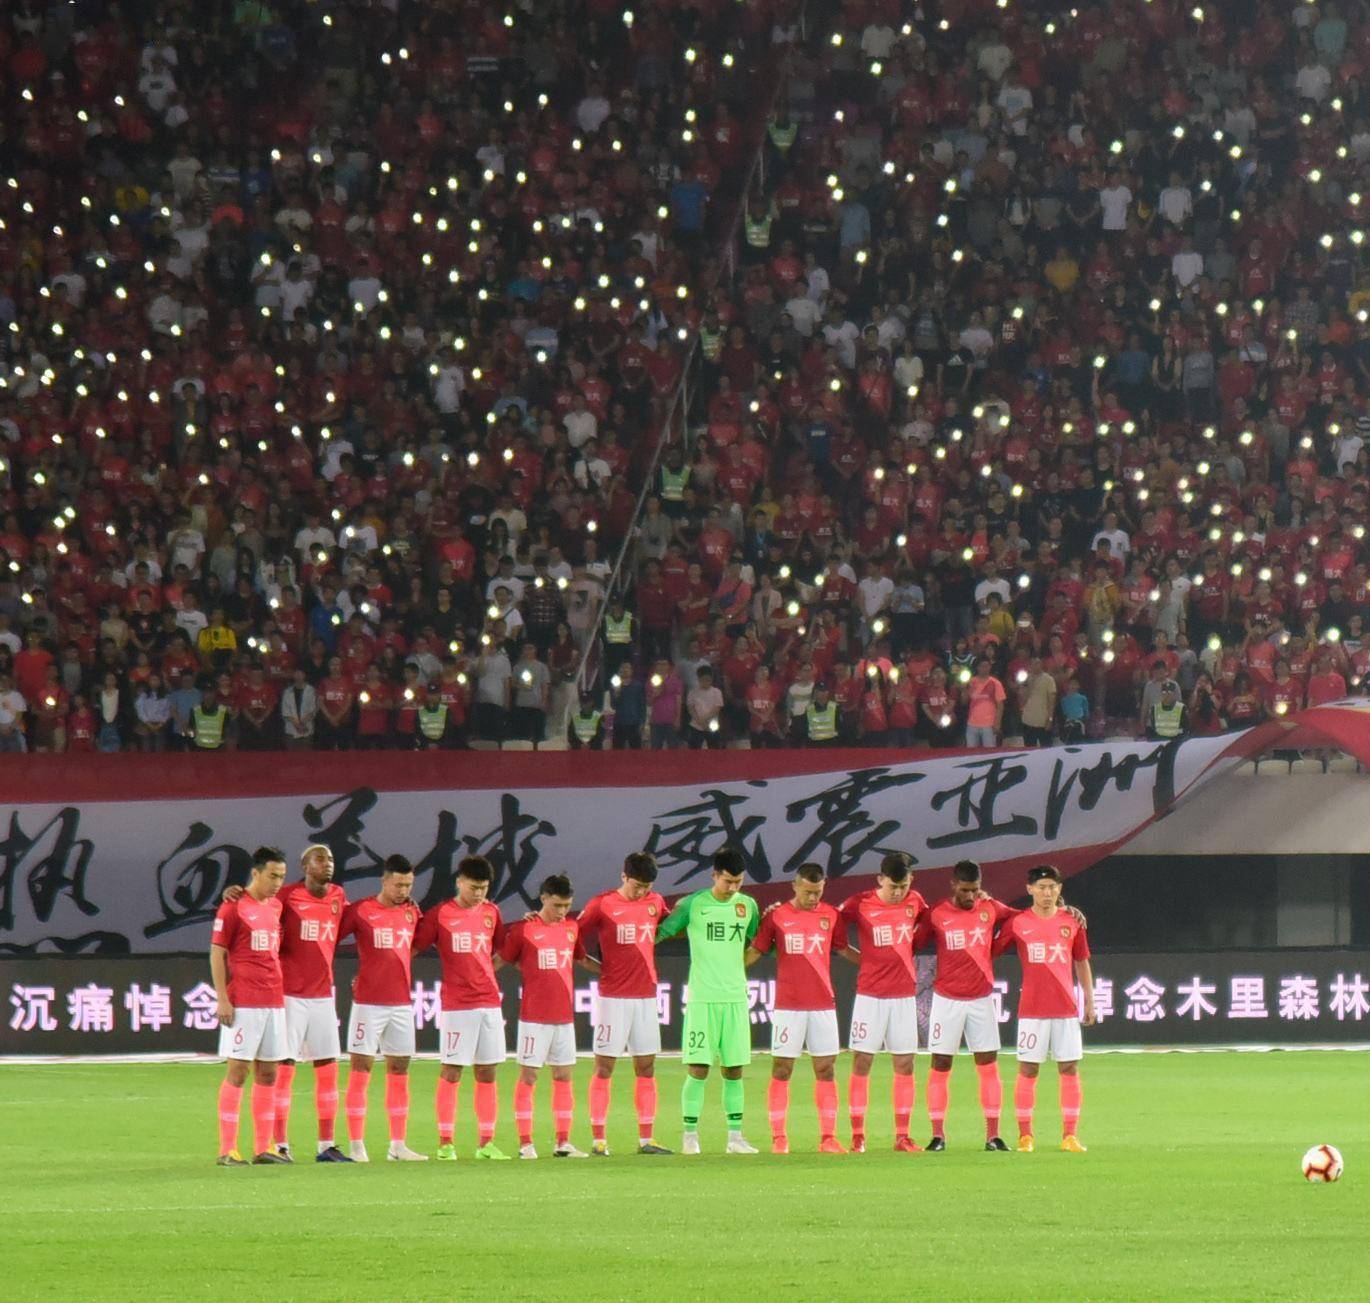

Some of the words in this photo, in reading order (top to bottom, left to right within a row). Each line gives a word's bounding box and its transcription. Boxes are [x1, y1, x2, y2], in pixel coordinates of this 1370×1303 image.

[641, 736, 1191, 884] 威震亚洲
[301, 920, 336, 942] 恒大
[373, 928, 414, 949] 恒大
[617, 922, 657, 944] 恒大
[706, 921, 745, 942] 恒大
[872, 923, 914, 947] 恒大
[945, 927, 987, 950] 恒大
[451, 932, 490, 953] 恒大
[784, 933, 826, 955] 恒大
[1027, 942, 1068, 964] 恒大
[538, 948, 573, 970] 恒大
[10, 982, 222, 1033] 沉痛悼念
[234, 1028, 243, 1045] 6
[355, 1022, 365, 1041] 5
[447, 1031, 461, 1050] 17
[597, 1023, 612, 1043] 21
[688, 1031, 706, 1049] 32
[774, 1025, 789, 1044] 16
[851, 1020, 867, 1040] 35
[932, 1022, 942, 1040] 8
[1018, 1031, 1037, 1050] 20
[524, 1036, 535, 1055] 11
